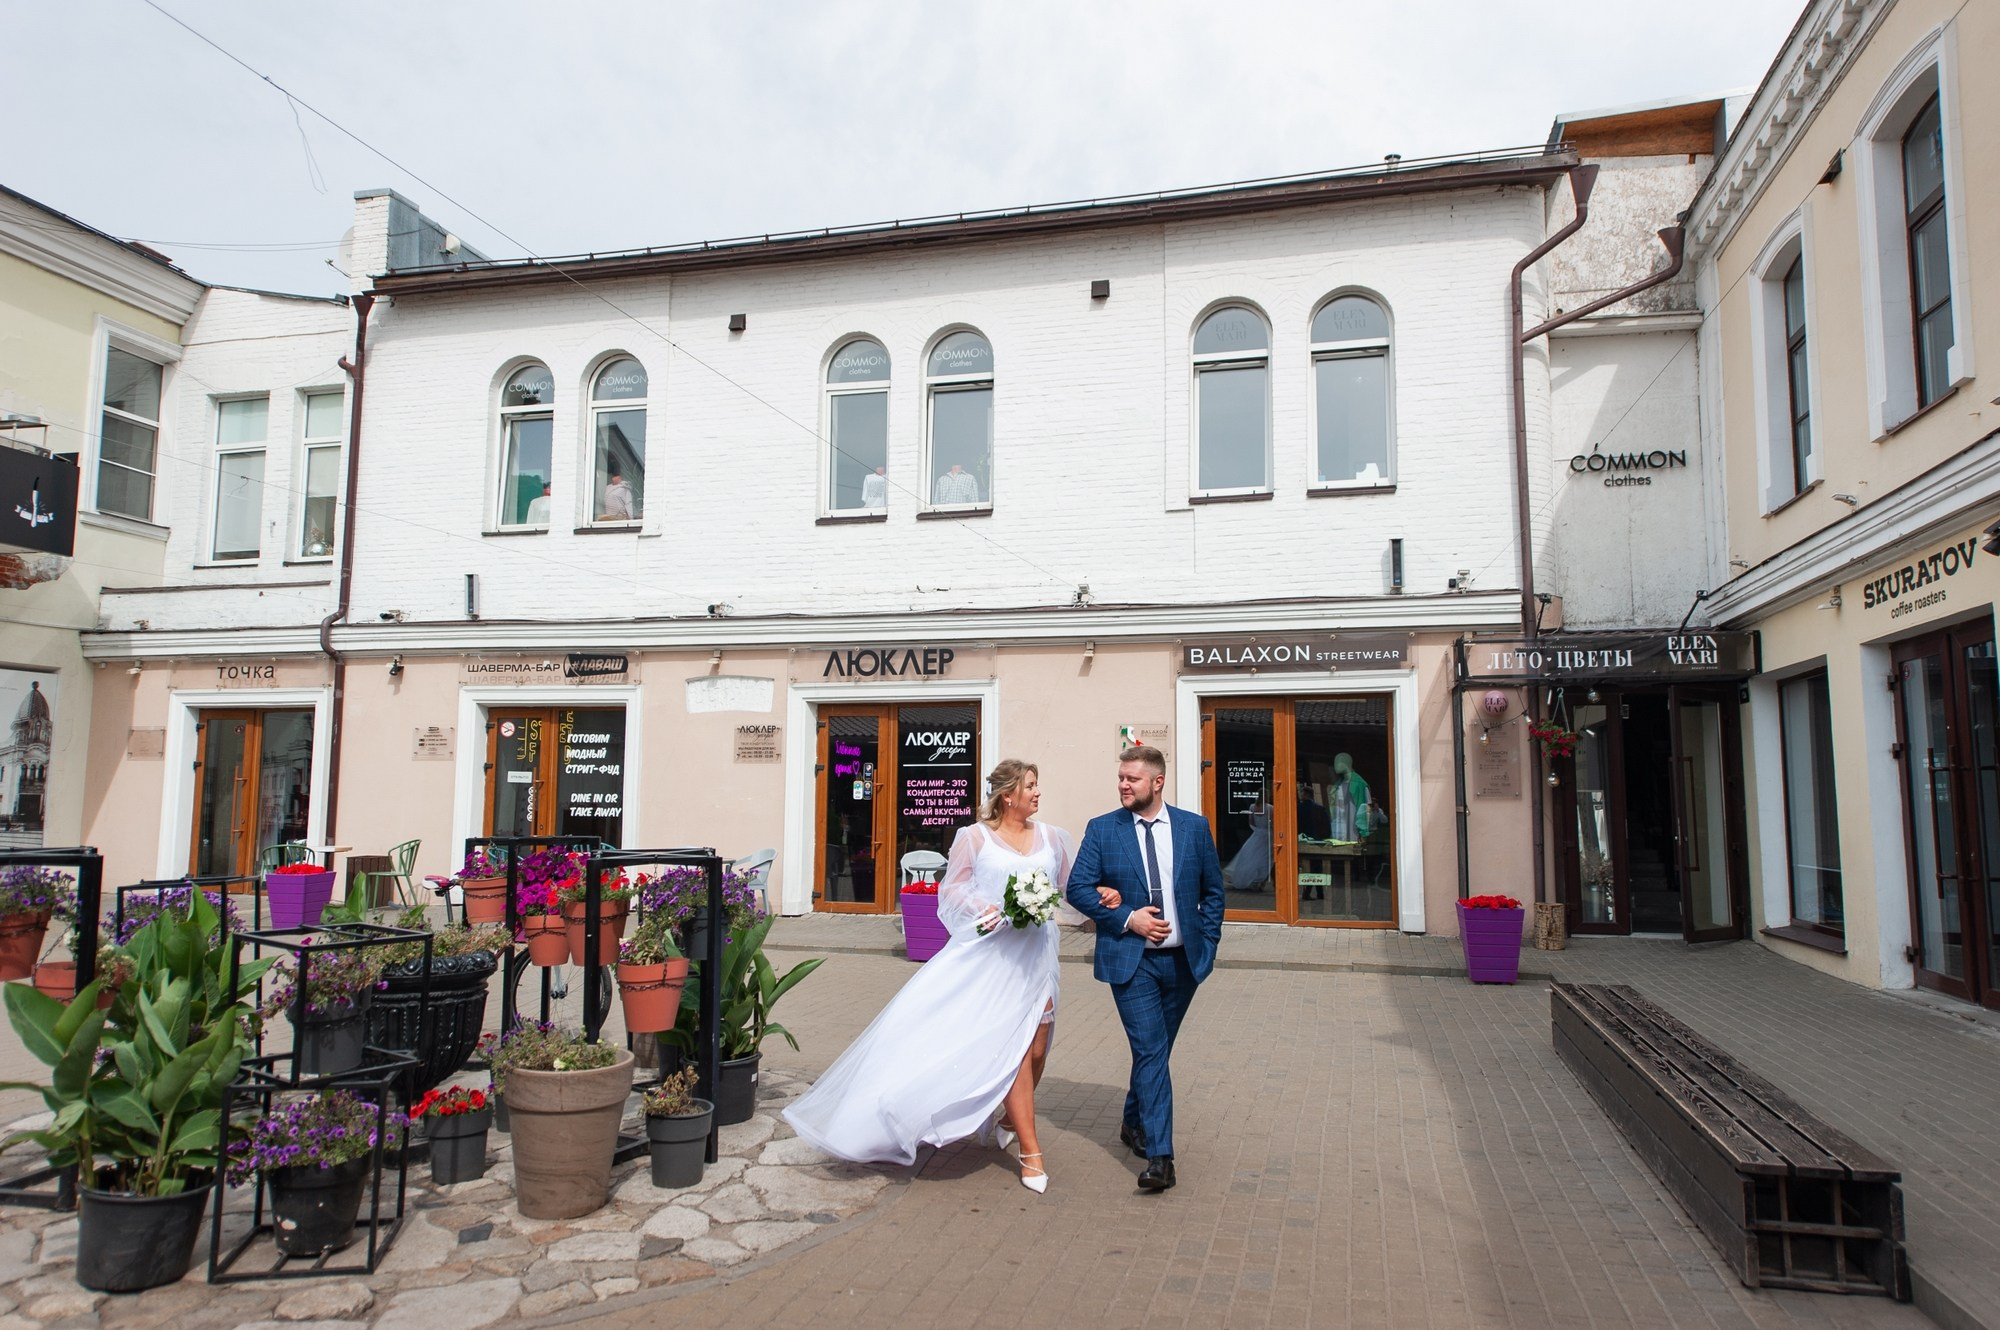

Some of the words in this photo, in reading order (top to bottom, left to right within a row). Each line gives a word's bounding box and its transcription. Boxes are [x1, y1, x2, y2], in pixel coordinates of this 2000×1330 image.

[950, 359, 973, 368] clothes
[849, 367, 871, 375] clothes
[612, 385, 633, 393] clothes
[1604, 473, 1652, 487] clothes
[1863, 537, 1977, 610] SKURATOV
[1890, 601, 1913, 619] coffee
[1914, 590, 1947, 611] roasters
[1667, 635, 1717, 650] ELEN
[1190, 645, 1310, 664] BALAXON
[1316, 650, 1400, 661] STREETWEAR
[1668, 650, 1718, 665] MARI
[823, 649, 955, 677] ЛЮКЛЕР
[1487, 651, 1543, 670] ЛЕТО
[1556, 650, 1633, 672] ЦВЕТЫ
[217, 665, 274, 679] точка
[467, 663, 561, 673] ШАВЕРМА-БАР
[740, 725, 777, 733] ЛЮКЛЕР
[566, 733, 610, 744] ГОТОВИМ
[905, 732, 971, 746] ЛЮКЛЕР
[566, 747, 607, 759] МОДНЫЙ
[928, 746, 966, 761] десерт
[565, 764, 620, 776] СТРИТ-ФУД
[570, 793, 592, 803] DINE
[593, 793, 602, 803] IN
[604, 793, 618, 803] OR
[906, 789, 967, 797] КОНДИТЕРСКАЯ,
[915, 798, 925, 806] ТО
[926, 798, 936, 806] ТЫ
[938, 798, 943, 806] В
[944, 797, 959, 806] НЕЙ
[569, 807, 592, 817] TAKE
[593, 807, 622, 818] AWAY
[903, 806, 933, 816] САМЫЙ
[934, 806, 971, 815] ВКУСНЫЙ
